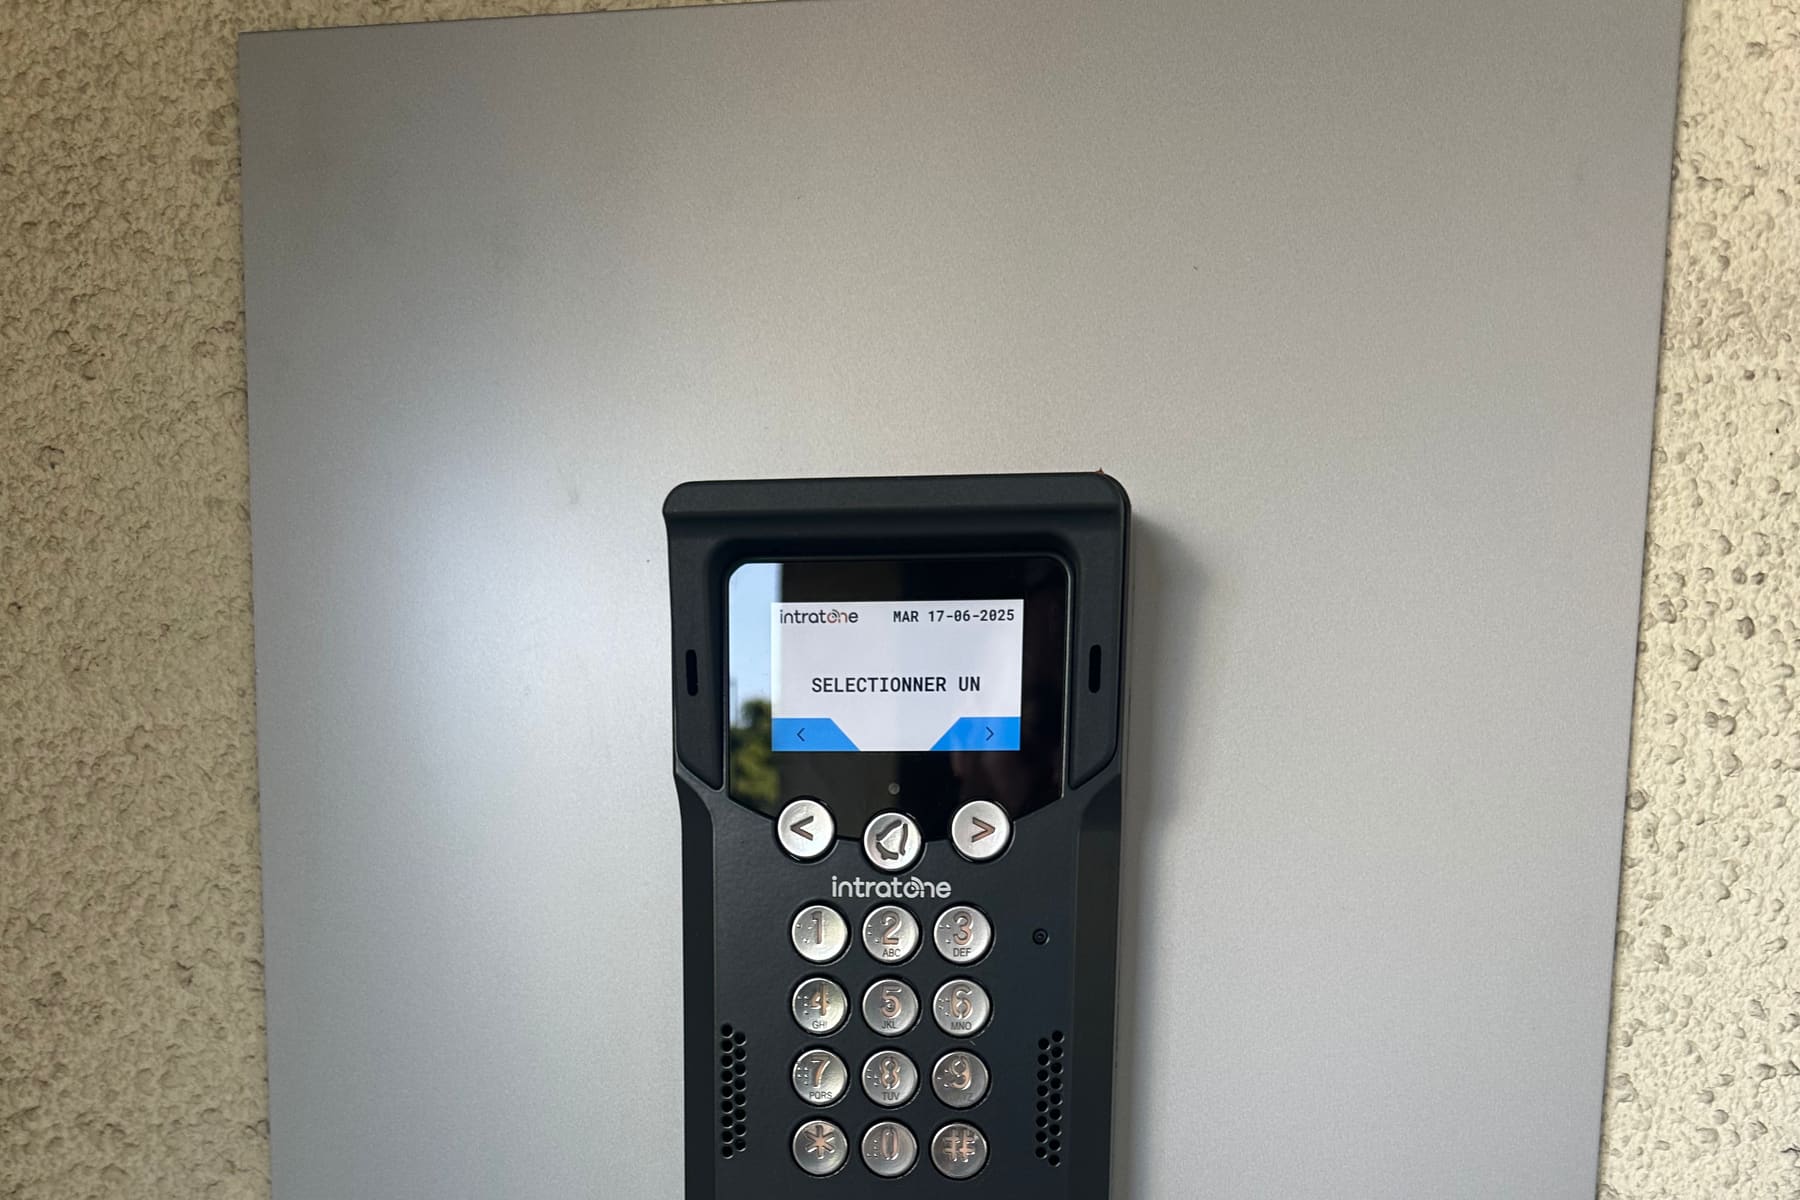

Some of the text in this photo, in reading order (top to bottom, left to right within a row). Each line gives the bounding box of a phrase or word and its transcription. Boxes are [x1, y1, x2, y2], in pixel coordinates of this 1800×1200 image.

[779, 608, 859, 625] intratone
[892, 608, 1016, 623] MAR 17-06-2025
[811, 676, 981, 693] SELECTIONNER UN
[831, 875, 952, 899] intratone
[810, 910, 823, 945] 1
[879, 910, 900, 945] 2
[952, 910, 973, 946] 3
[881, 947, 901, 958] ABC
[952, 947, 972, 958] DEF
[810, 982, 831, 1017] 4
[879, 985, 902, 1018] 5
[950, 985, 973, 1020] 6
[950, 1020, 972, 1031] MNO
[809, 1056, 831, 1088] 7
[879, 1055, 900, 1090] 8
[950, 1055, 972, 1090] 9
[808, 1090, 833, 1101] PQRS
[881, 1090, 900, 1101] TUV
[879, 1126, 899, 1161] 0
